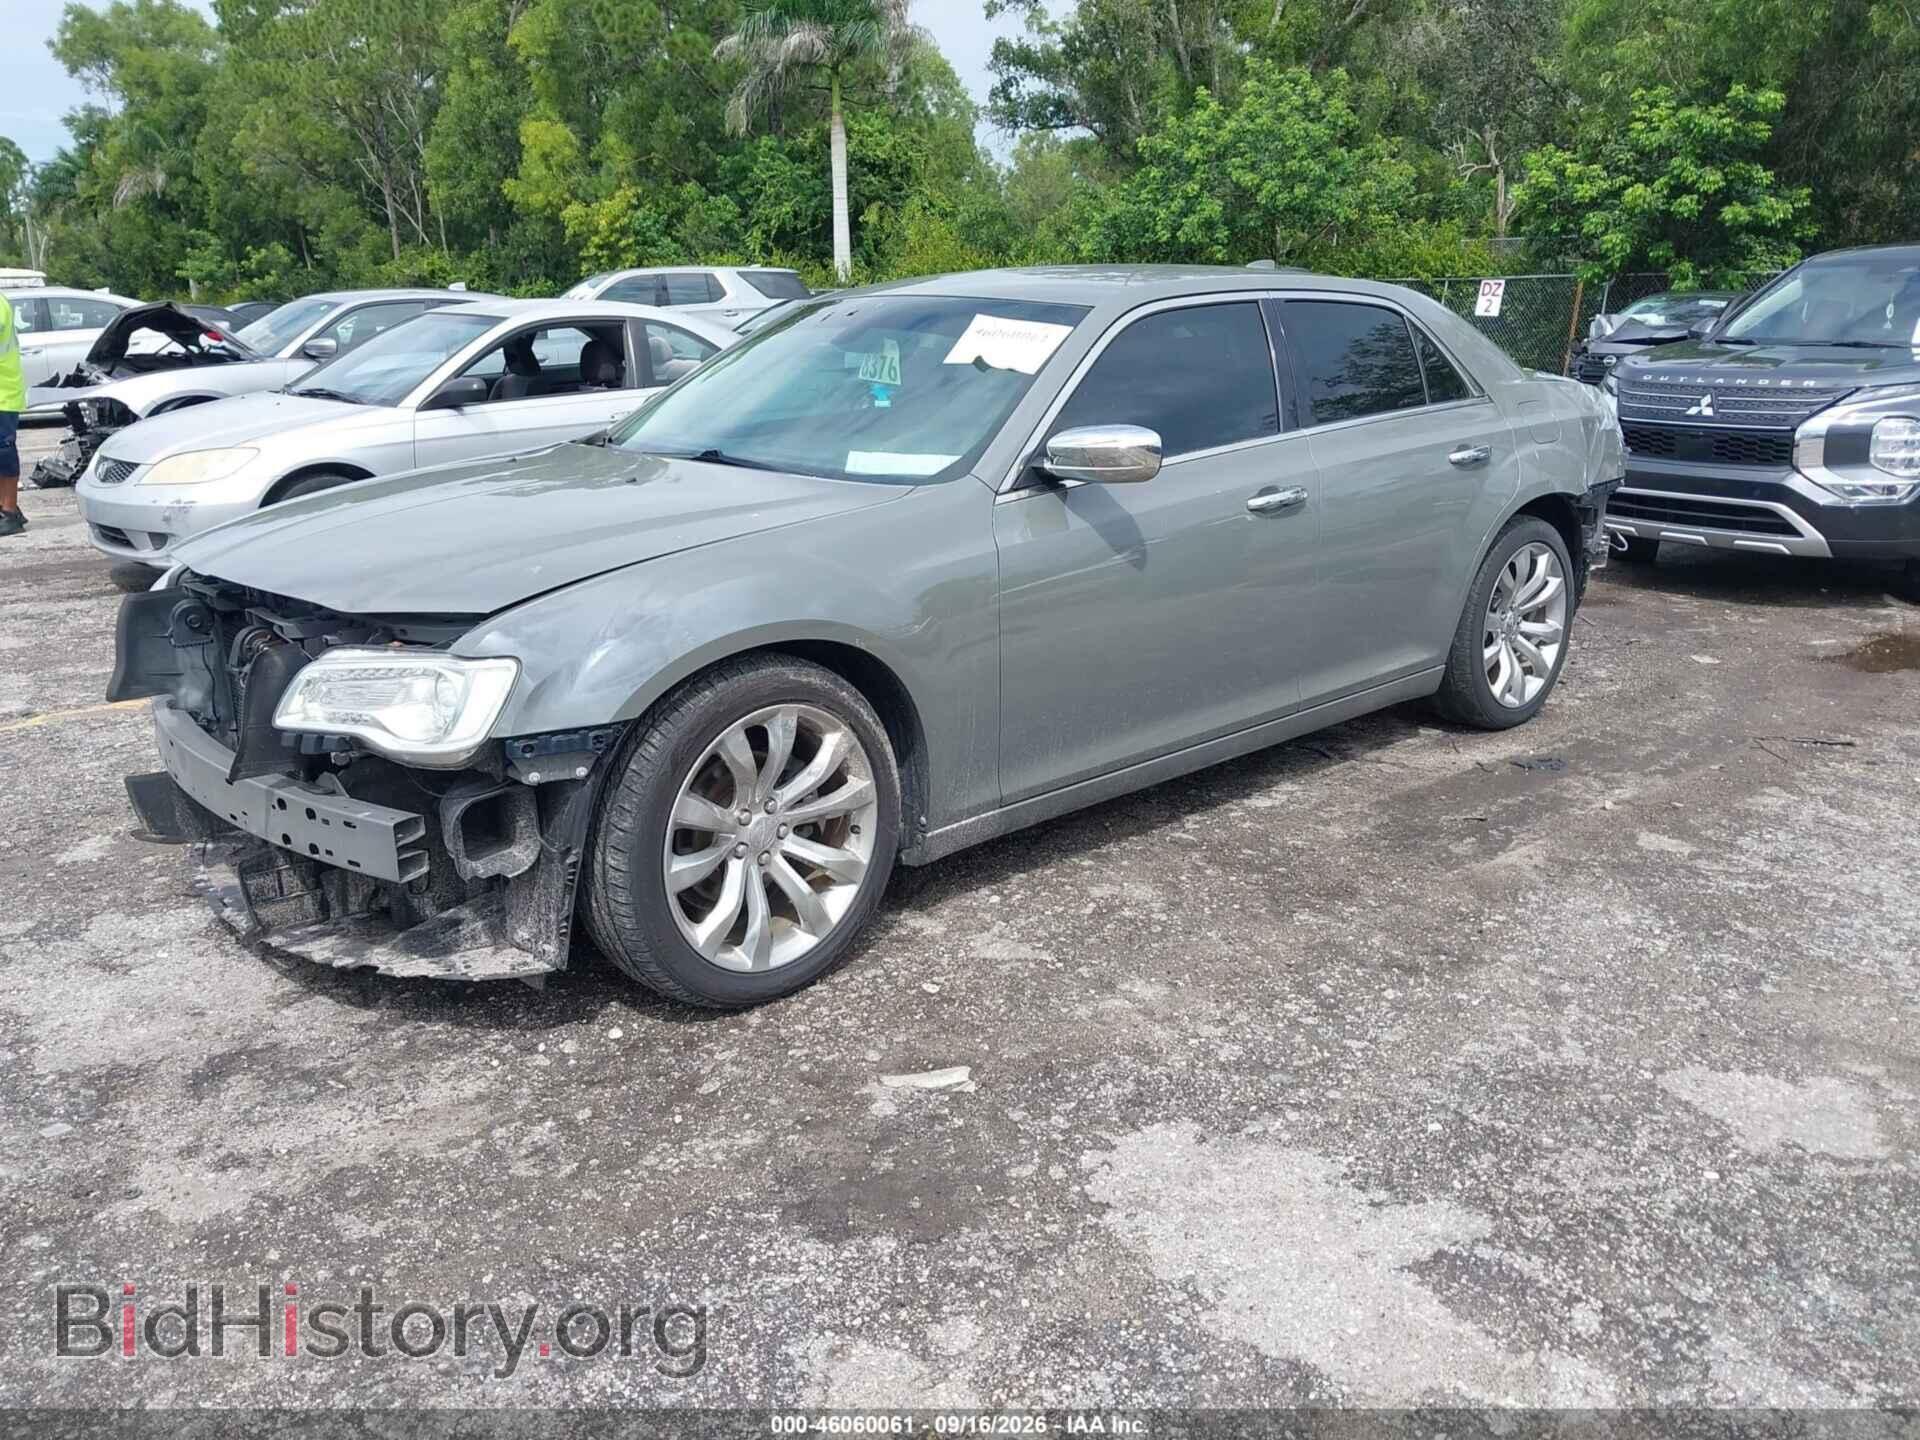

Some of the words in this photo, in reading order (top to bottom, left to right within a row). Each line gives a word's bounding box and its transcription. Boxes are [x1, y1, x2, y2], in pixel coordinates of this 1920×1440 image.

[1482, 282, 1502, 296] DZ
[1484, 299, 1494, 312] 2
[1643, 375, 1817, 387] OUTLANDER
